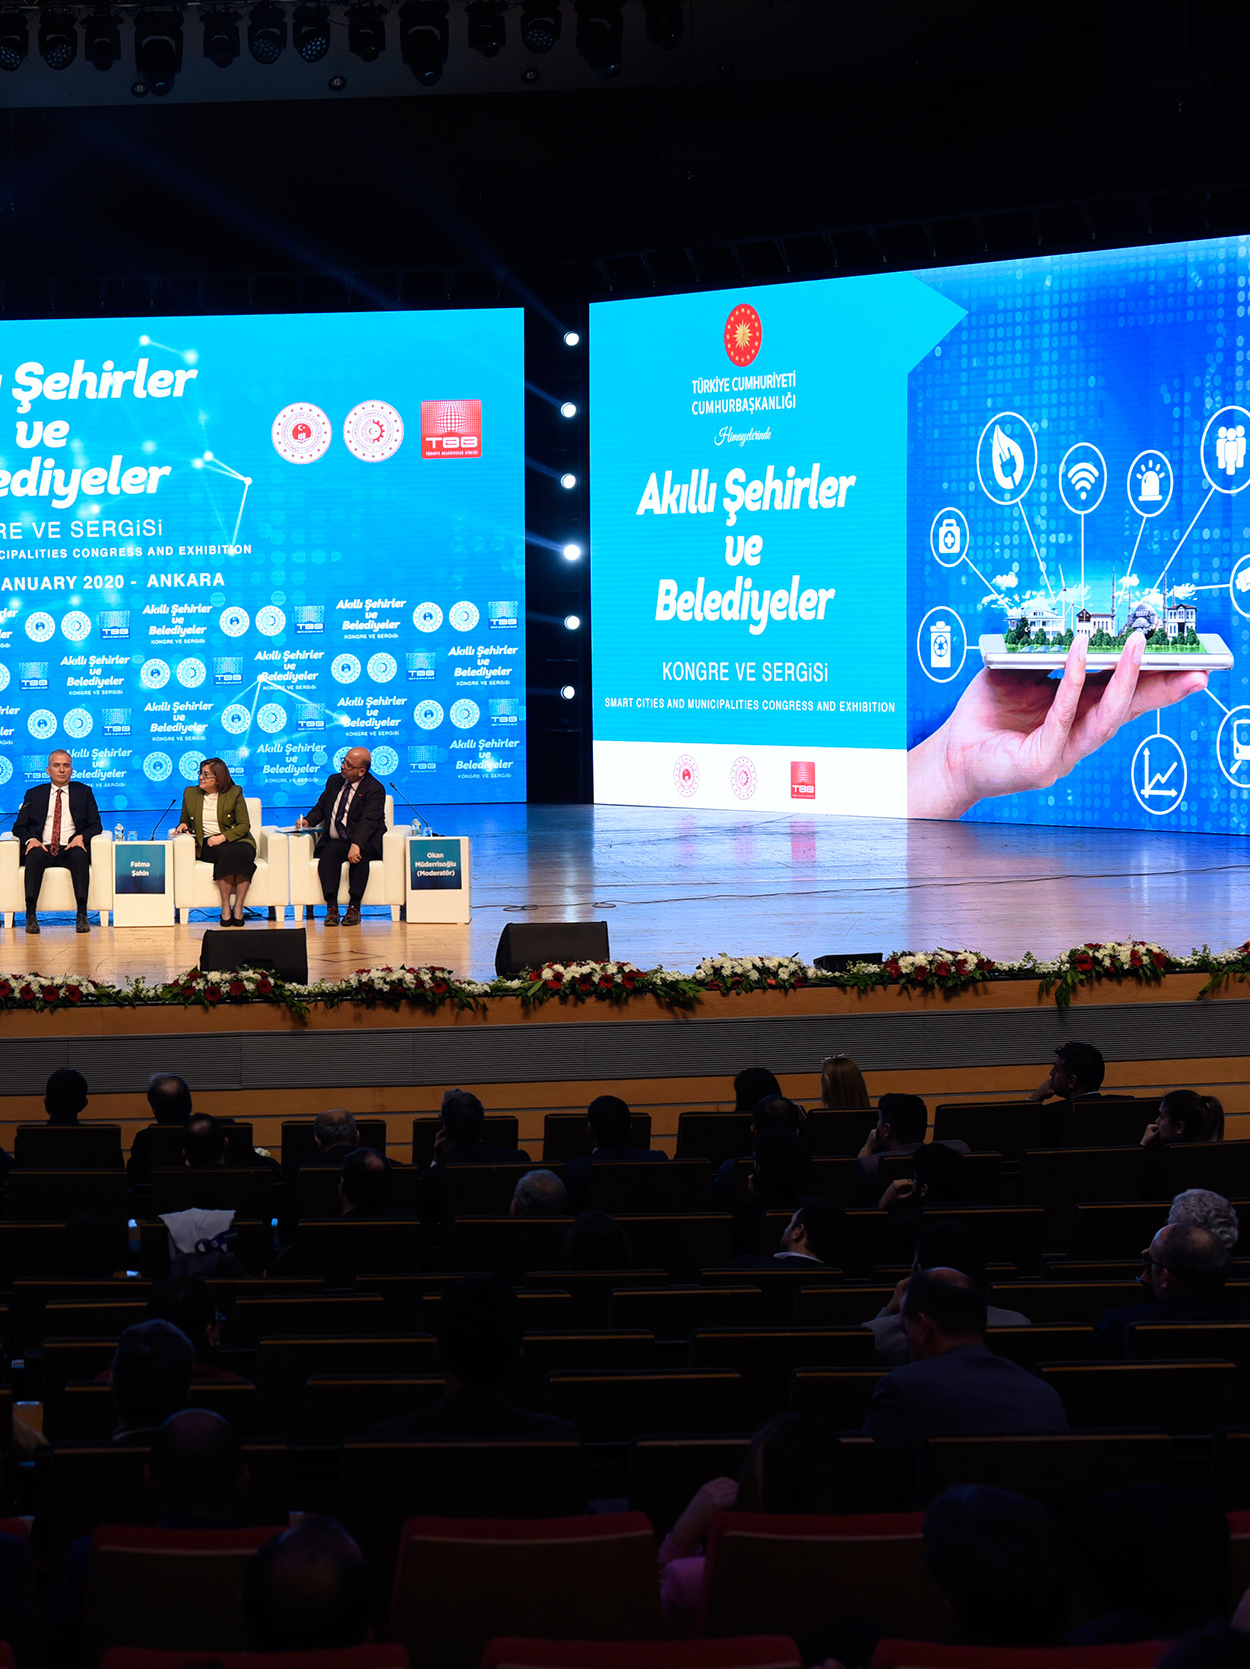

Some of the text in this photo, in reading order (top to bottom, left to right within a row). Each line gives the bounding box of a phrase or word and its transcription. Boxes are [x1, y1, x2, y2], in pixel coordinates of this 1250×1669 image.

[12, 356, 198, 413] Şehirler
[692, 370, 795, 394] TÜRKİYE CUMHURİYETİ
[692, 392, 795, 415] CUMHURBAŞKANLIĞI
[16, 420, 69, 448] ve
[714, 426, 771, 447] Himayelerinde
[426, 436, 478, 449] TBB
[636, 463, 856, 526] Akıllı Şehirler
[32, 522, 61, 539] VE
[73, 546, 143, 558] CONGRESS
[147, 545, 174, 556] AND
[725, 535, 763, 566] ve
[83, 573, 124, 588] 2020
[147, 572, 224, 587] ANKARA
[170, 603, 212, 616] Şehirler
[364, 598, 406, 611] Şehirler
[655, 575, 836, 635] Belediyeler
[149, 625, 207, 637] Belediyeler
[343, 620, 401, 632] Belediyeler
[282, 650, 324, 662] Şehirler
[476, 645, 517, 658] Şehirler
[88, 654, 130, 667] Şehirler
[261, 671, 319, 684] Belediyeler
[454, 666, 512, 679] Belediyeler
[663, 662, 729, 681] KONGRE
[736, 663, 756, 681] VE
[67, 676, 125, 688] Belediyeler
[172, 701, 214, 714] Şehirler
[365, 696, 407, 709] Şehirler
[605, 698, 894, 712] SMART CITIES AND MUNICIPALITIES CONGRESS AND EXHIBITION
[150, 722, 208, 735] Belediyeler
[344, 718, 402, 730] Belediyeler
[792, 784, 814, 794] TBB
